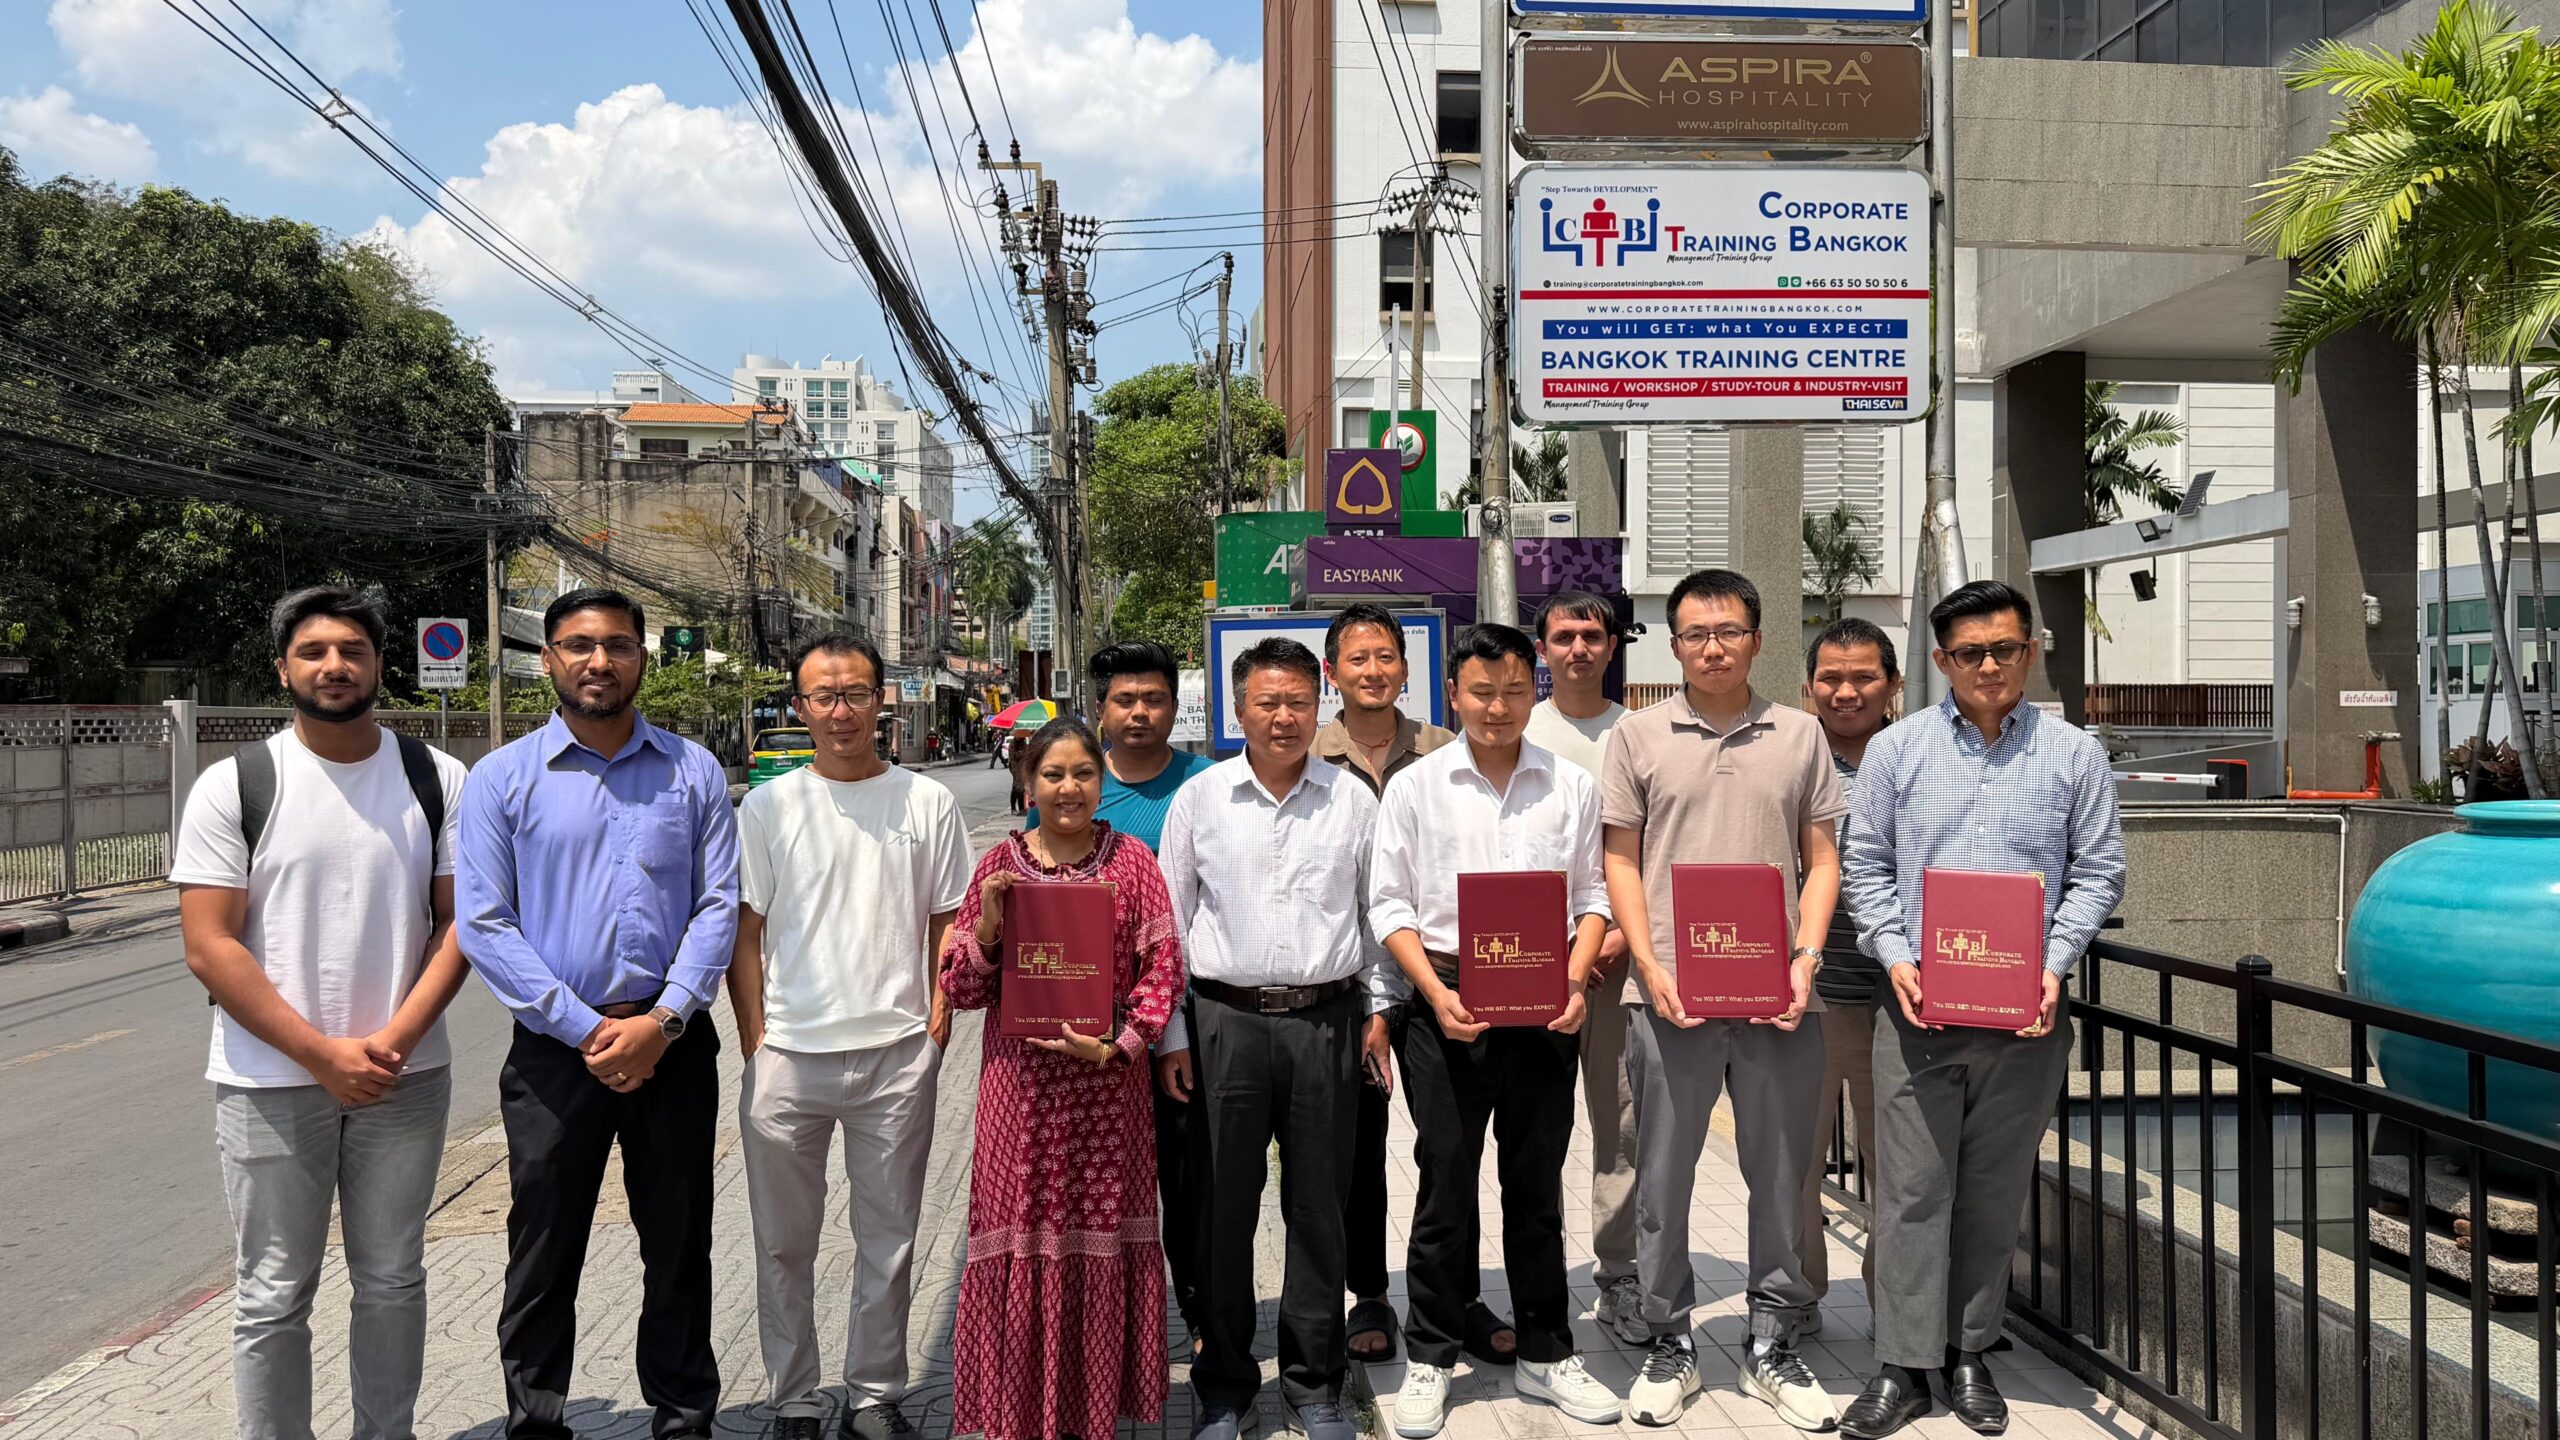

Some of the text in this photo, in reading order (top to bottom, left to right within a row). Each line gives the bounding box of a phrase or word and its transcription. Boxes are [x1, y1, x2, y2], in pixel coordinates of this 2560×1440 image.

[1659, 90, 1872, 107] HOSPITALITY
[1677, 118, 1848, 134] www.aspirahospitality.com
[1667, 252, 1773, 264] Management Training Group
[1553, 280, 1704, 288] training@corporatetrainingbangkok.com
[1805, 278, 1908, 288] +66 63 50 50 50 6
[1556, 323, 1891, 335] You will GET: what You EXPECT!
[1542, 350, 1906, 369] BANGKOK TRAINING CENTRE
[1548, 382, 1609, 392] TRAINING
[1623, 382, 1698, 392] WORKSHOP
[1711, 381, 1790, 392] STUDY-TOUR
[1793, 381, 1802, 391] &
[1806, 381, 1903, 391] INDUSTRY-VISIT
[1544, 399, 1649, 410] Management Training Group
[1324, 569, 1403, 582] EASYBANK
[1539, 674, 1553, 684] LO
